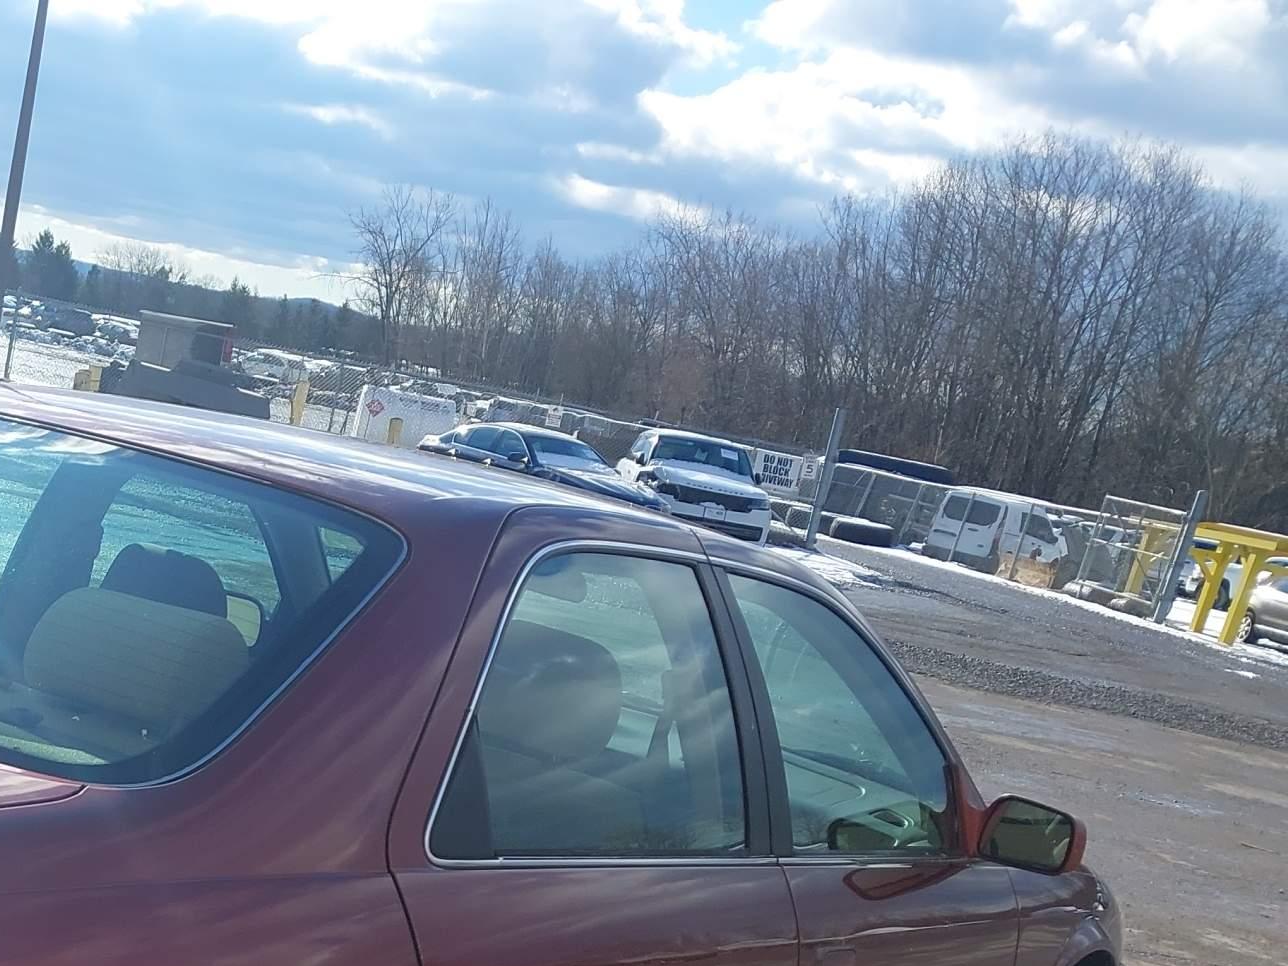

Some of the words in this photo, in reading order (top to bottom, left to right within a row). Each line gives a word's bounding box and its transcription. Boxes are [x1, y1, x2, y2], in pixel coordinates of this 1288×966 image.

[764, 454, 776, 464] DO
[777, 456, 793, 468] NOT
[763, 464, 790, 477] BLOCK
[806, 464, 814, 474] 5
[762, 473, 793, 488] IVEWAY
